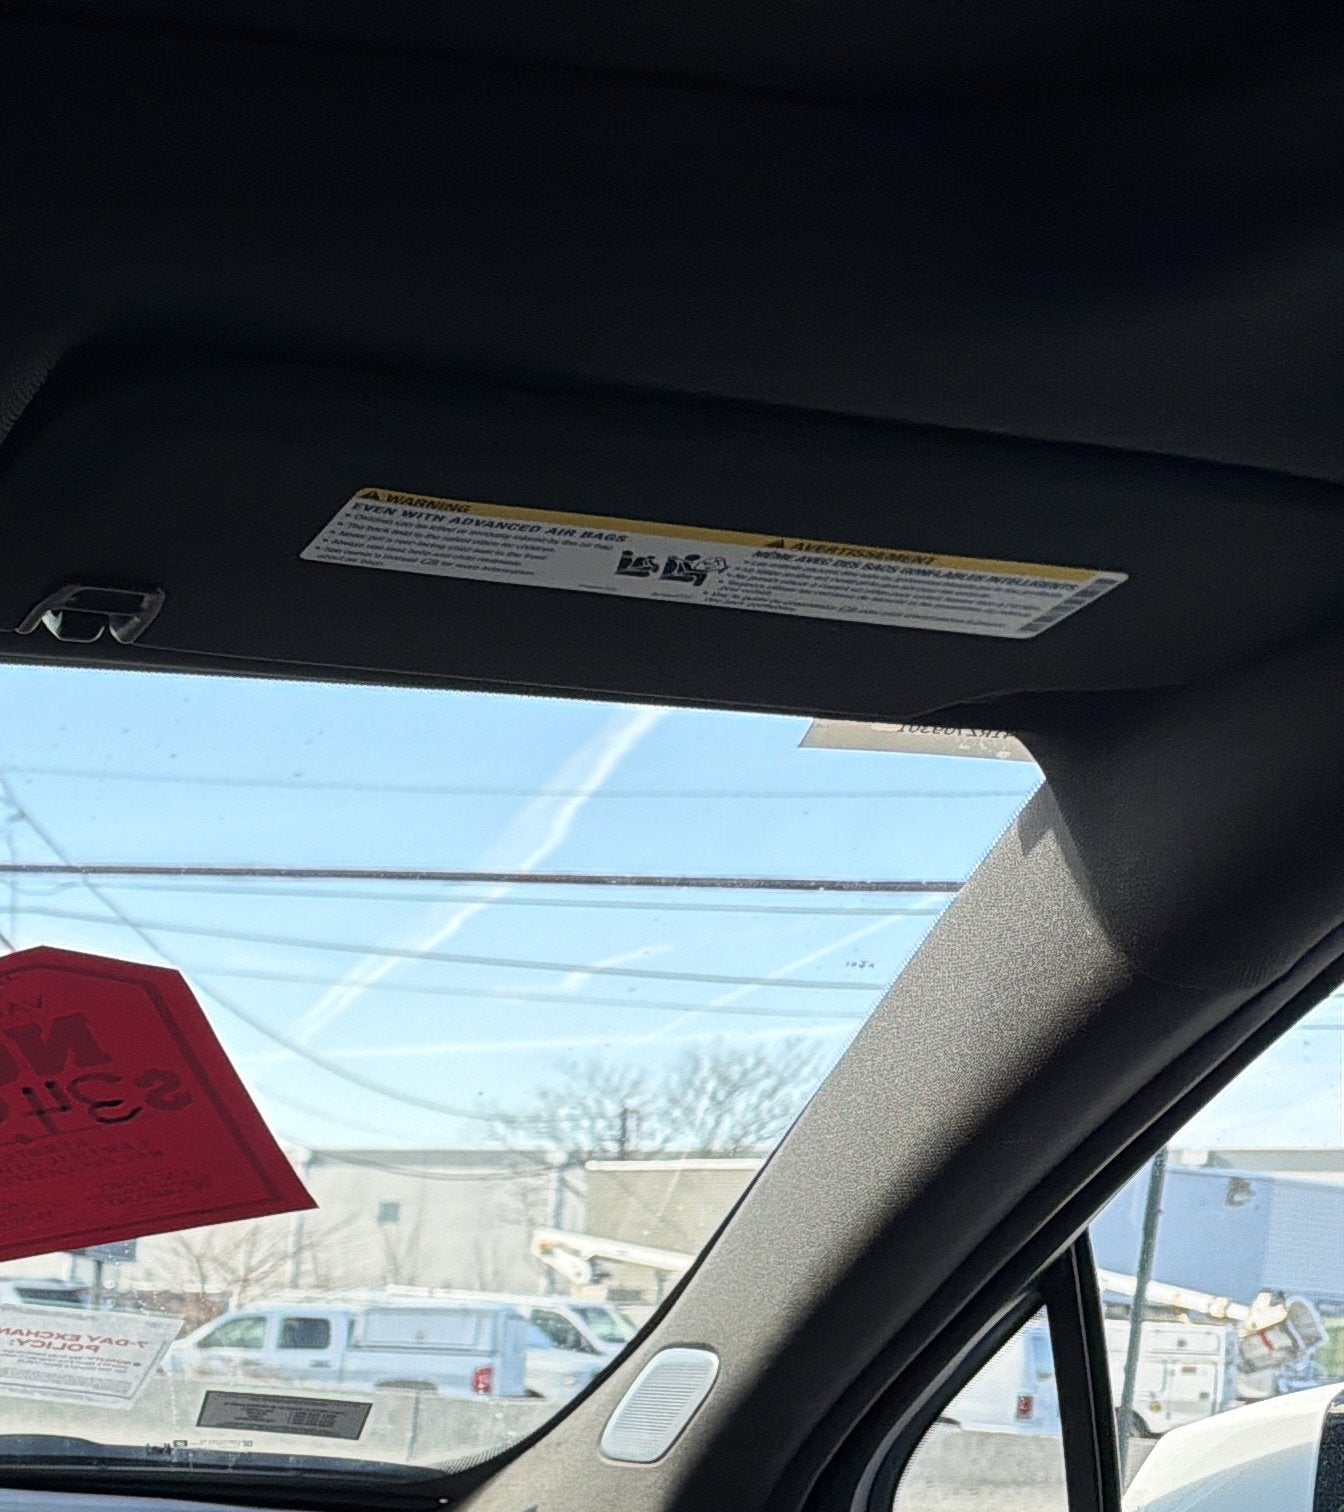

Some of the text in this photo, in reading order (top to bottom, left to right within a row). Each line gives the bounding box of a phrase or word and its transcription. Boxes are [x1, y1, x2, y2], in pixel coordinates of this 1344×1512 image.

[385, 492, 471, 514] WARNING
[350, 502, 629, 543] EVEN WITH ADVANCED AIR BAGS
